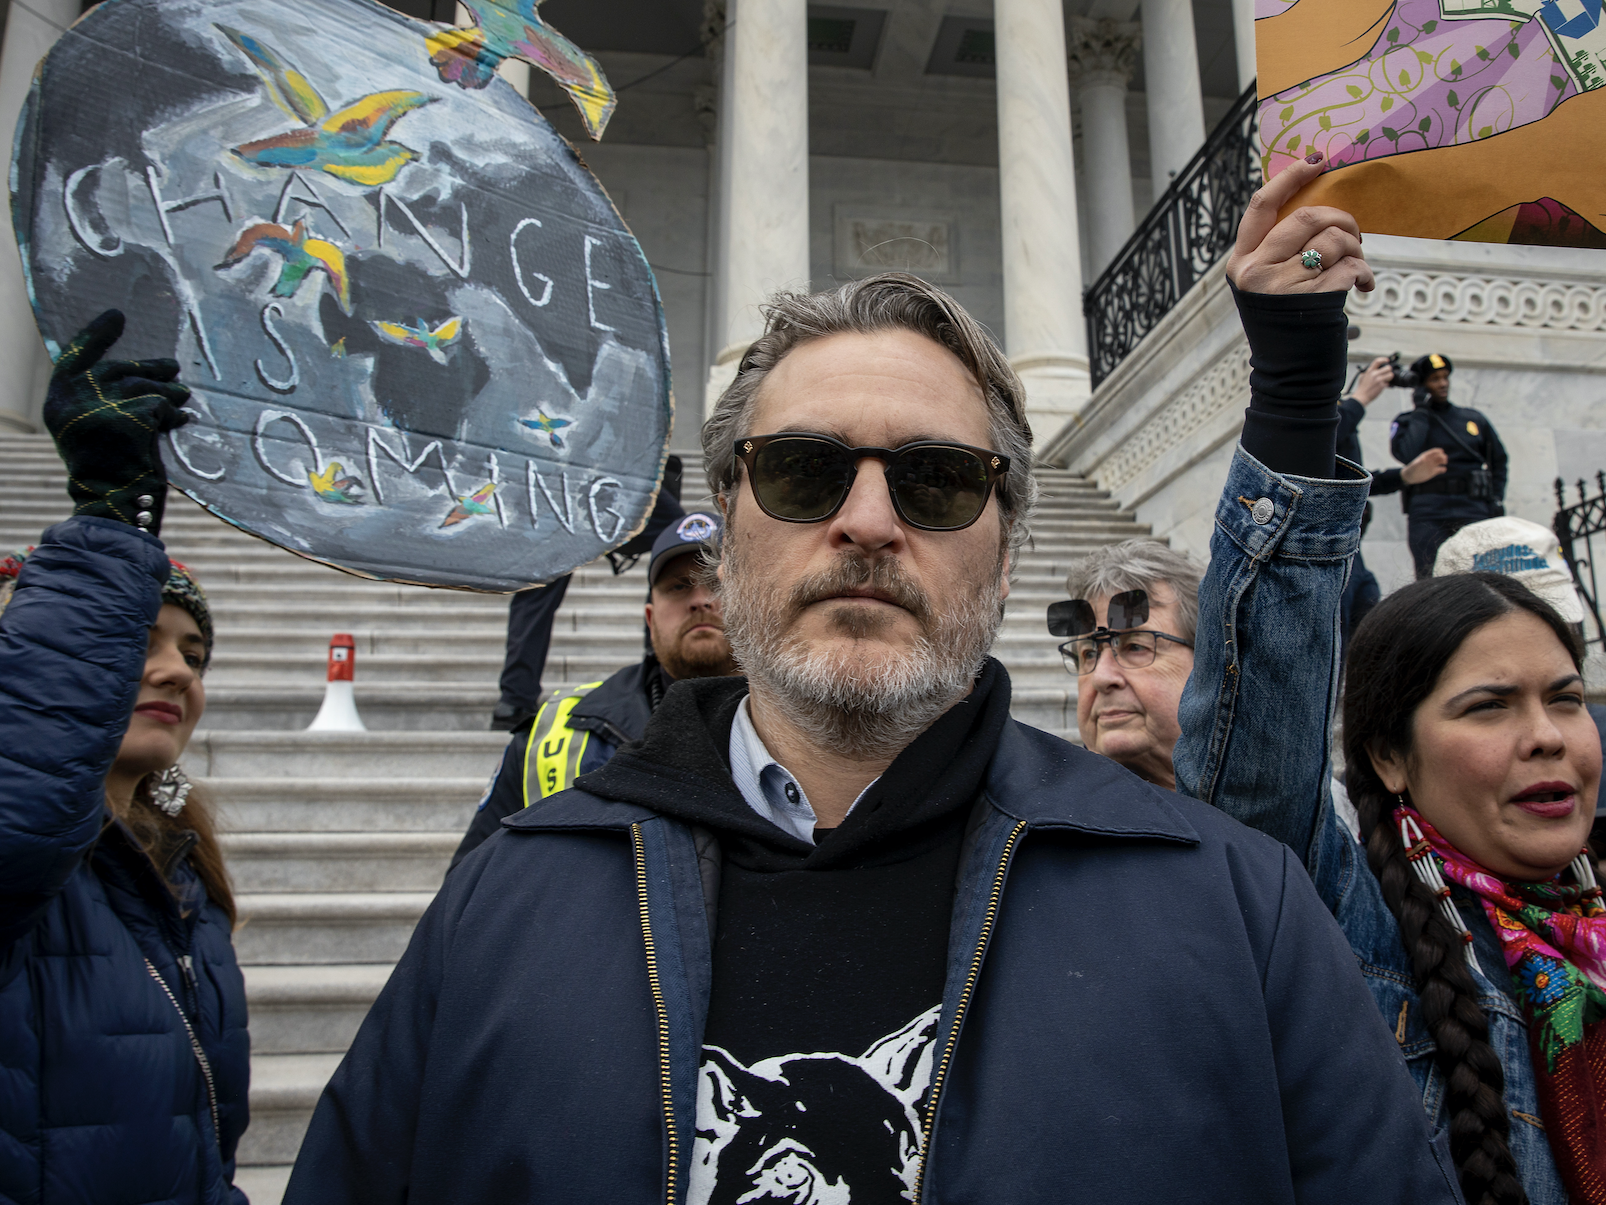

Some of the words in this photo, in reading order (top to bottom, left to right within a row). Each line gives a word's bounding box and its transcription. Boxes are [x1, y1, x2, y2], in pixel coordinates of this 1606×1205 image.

[64, 164, 616, 331] CHANGE
[186, 302, 300, 394] IS
[168, 407, 625, 542] COMING
